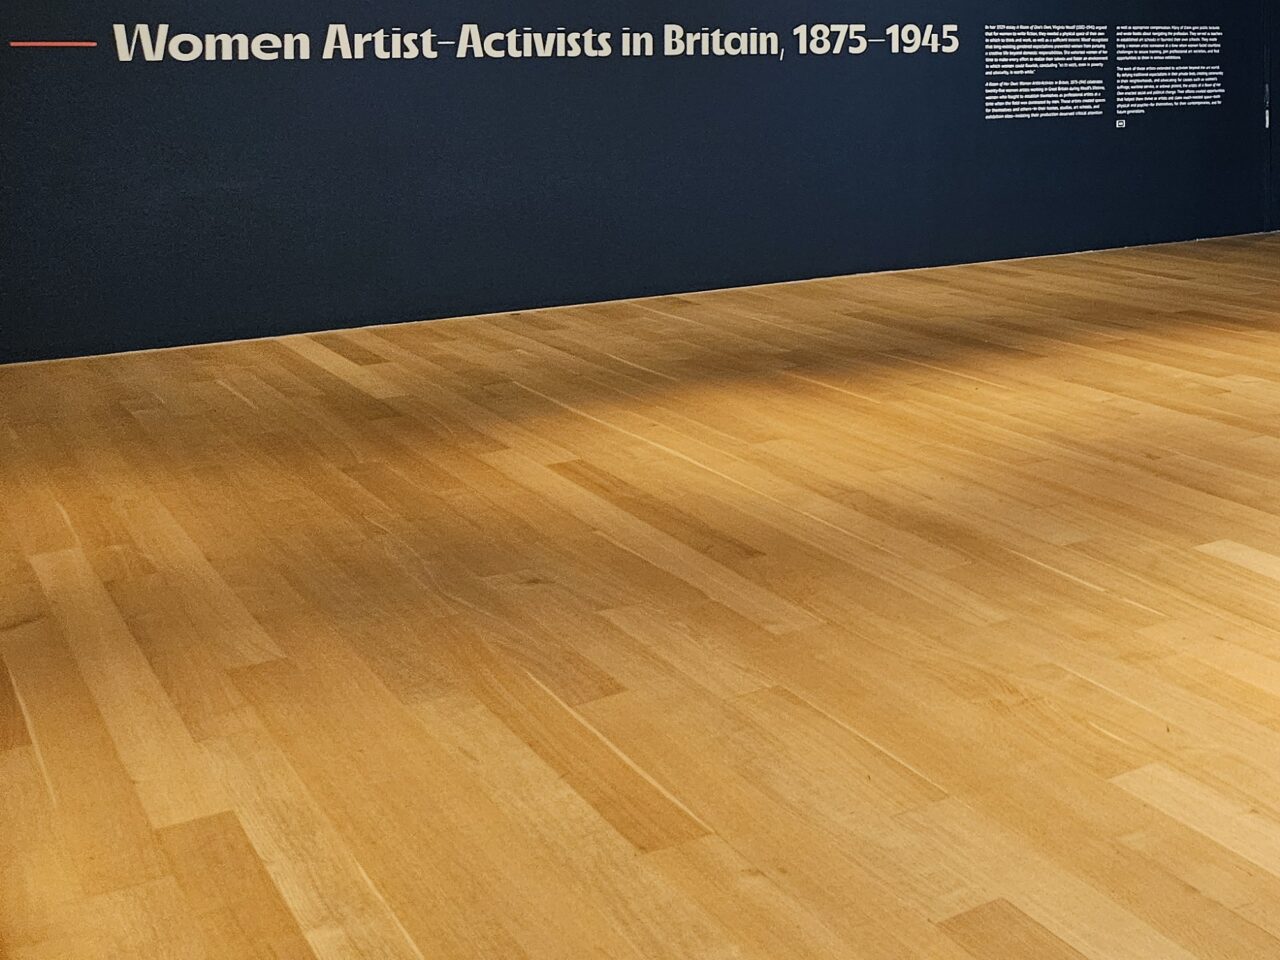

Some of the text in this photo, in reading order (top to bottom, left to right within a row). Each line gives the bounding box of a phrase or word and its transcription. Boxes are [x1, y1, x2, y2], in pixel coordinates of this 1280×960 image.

[113, 24, 959, 62] Women Artist-Activists in Britain, 1875–1945
